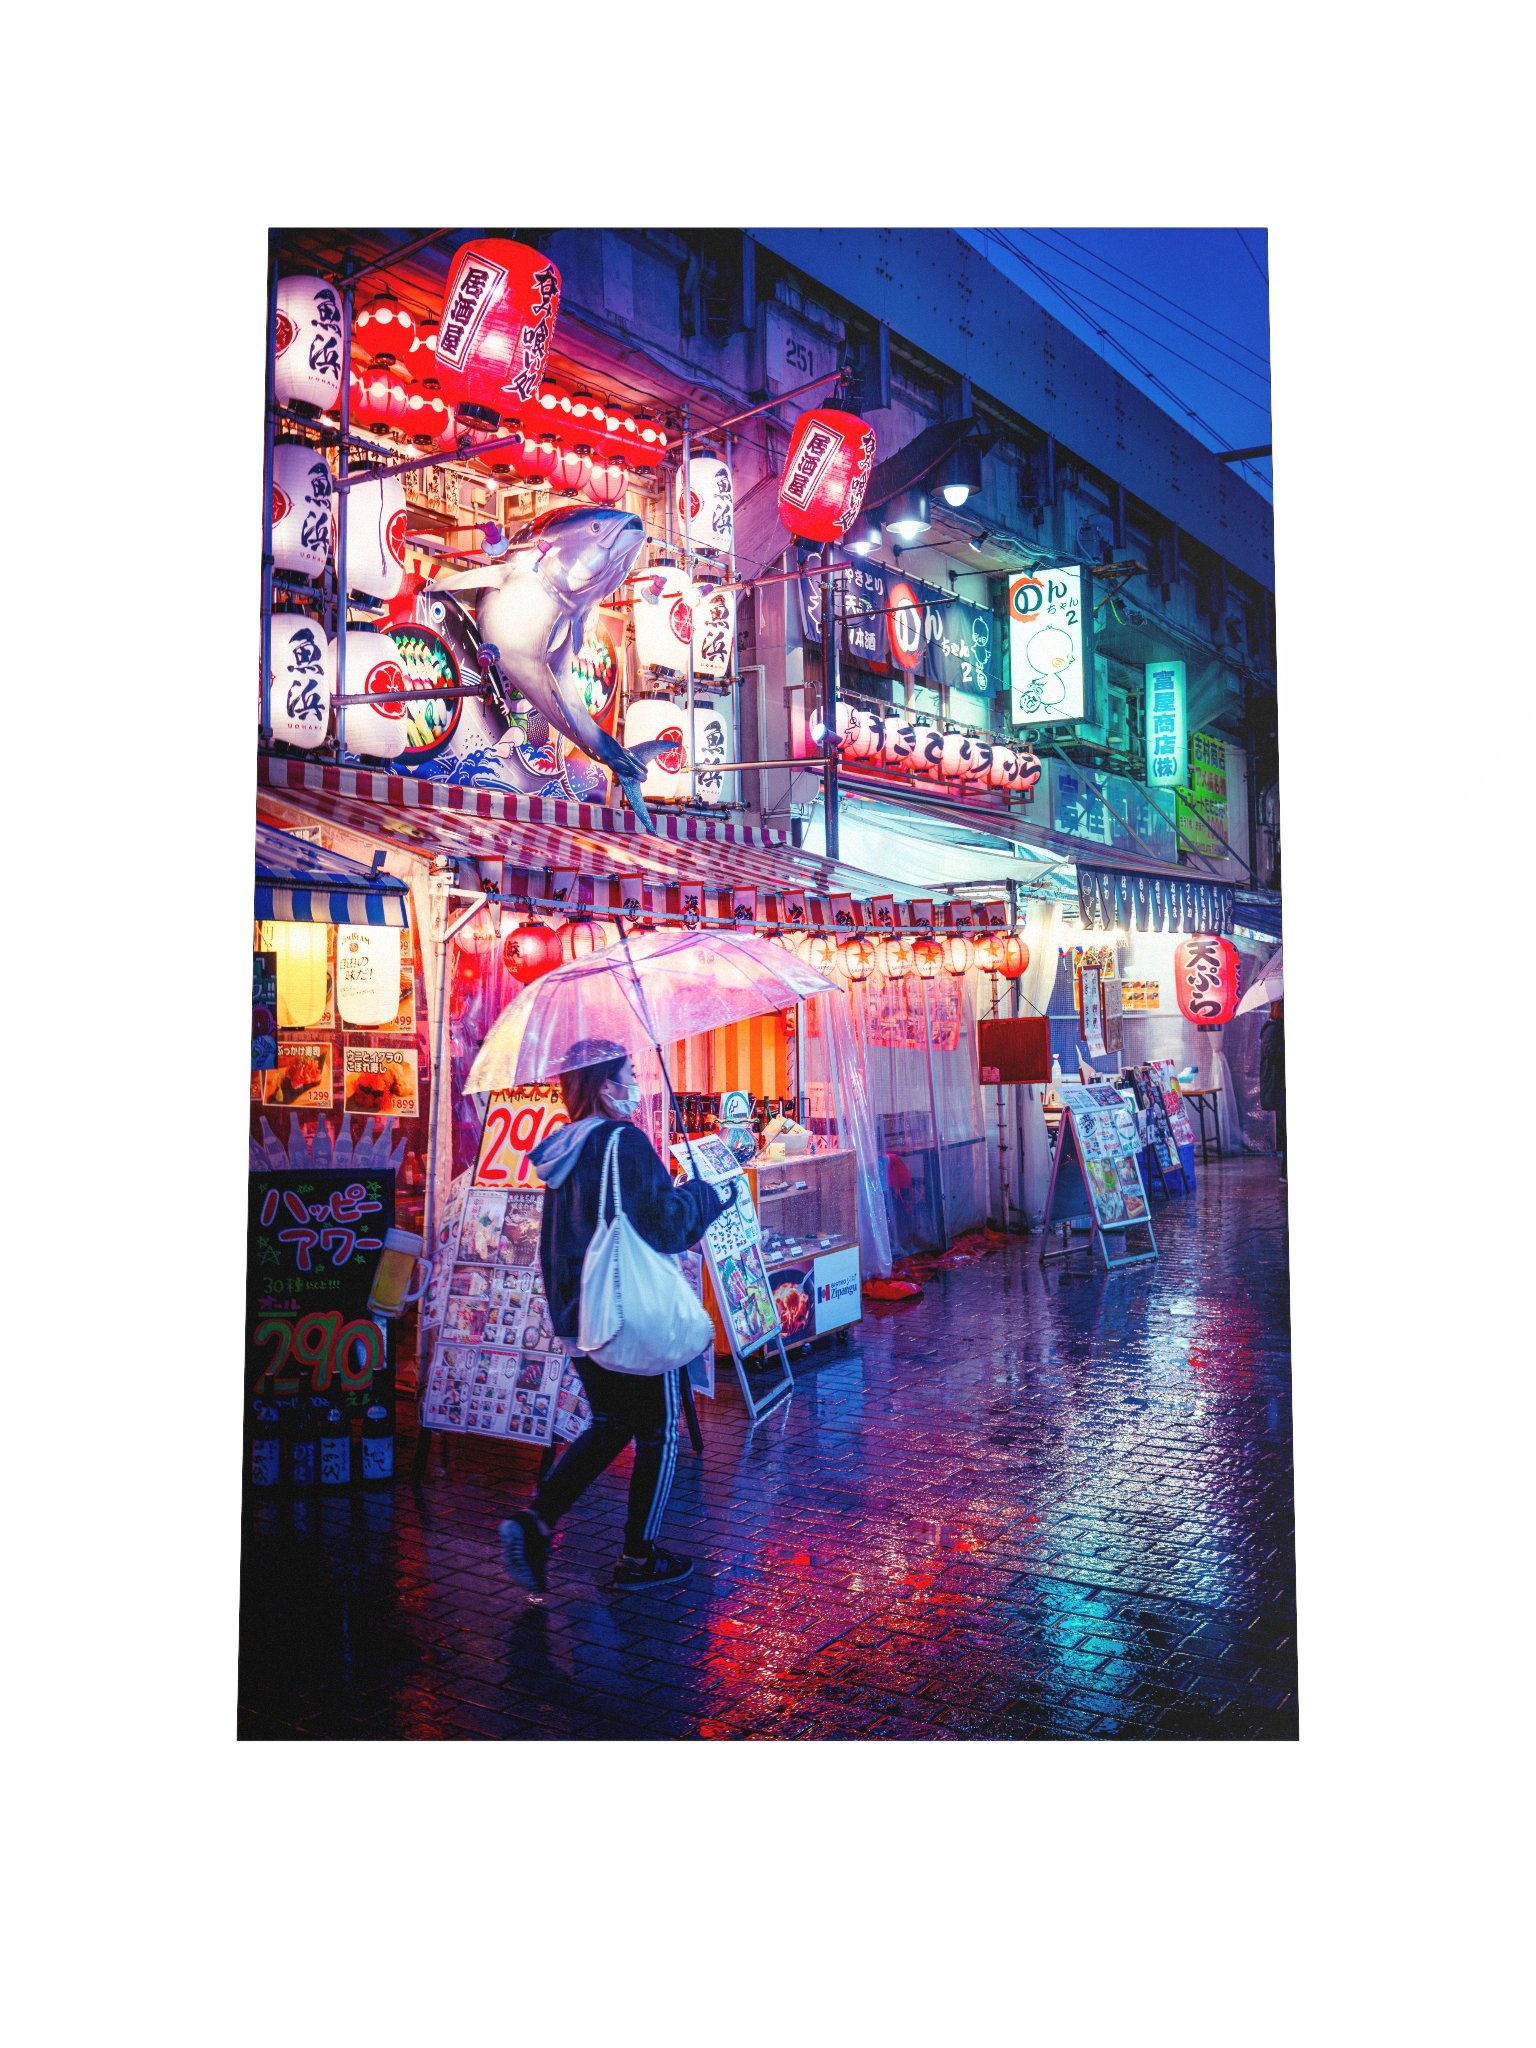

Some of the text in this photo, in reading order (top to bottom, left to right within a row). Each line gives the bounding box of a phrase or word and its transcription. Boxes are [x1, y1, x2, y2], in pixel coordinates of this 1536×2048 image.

[309, 288, 342, 380] 魚浜
[440, 266, 490, 356] 居酒屋
[786, 337, 814, 377] 251
[788, 432, 831, 498] 居酒屋
[301, 462, 332, 556] 魚浜
[712, 467, 733, 535] 魚浜
[845, 568, 883, 596] やきとり
[1014, 579, 1079, 626] のん ちゃん 2
[701, 594, 730, 662] 魚浜
[894, 599, 972, 683] のん ちゃん 2
[285, 627, 326, 722] 魚浜
[698, 720, 726, 788] 魚浜
[1185, 940, 1222, 1017] 天ぷら
[346, 1050, 404, 1064] ウニとイクラの
[346, 1061, 387, 1074] こぼれ寿し
[309, 1091, 329, 1101] 1299
[391, 1099, 415, 1109] 1899
[260, 1183, 383, 1227] ハッピー
[277, 1227, 384, 1271] アワー
[831, 1283, 857, 1300] Zipangu
[253, 1311, 385, 1393] 290
